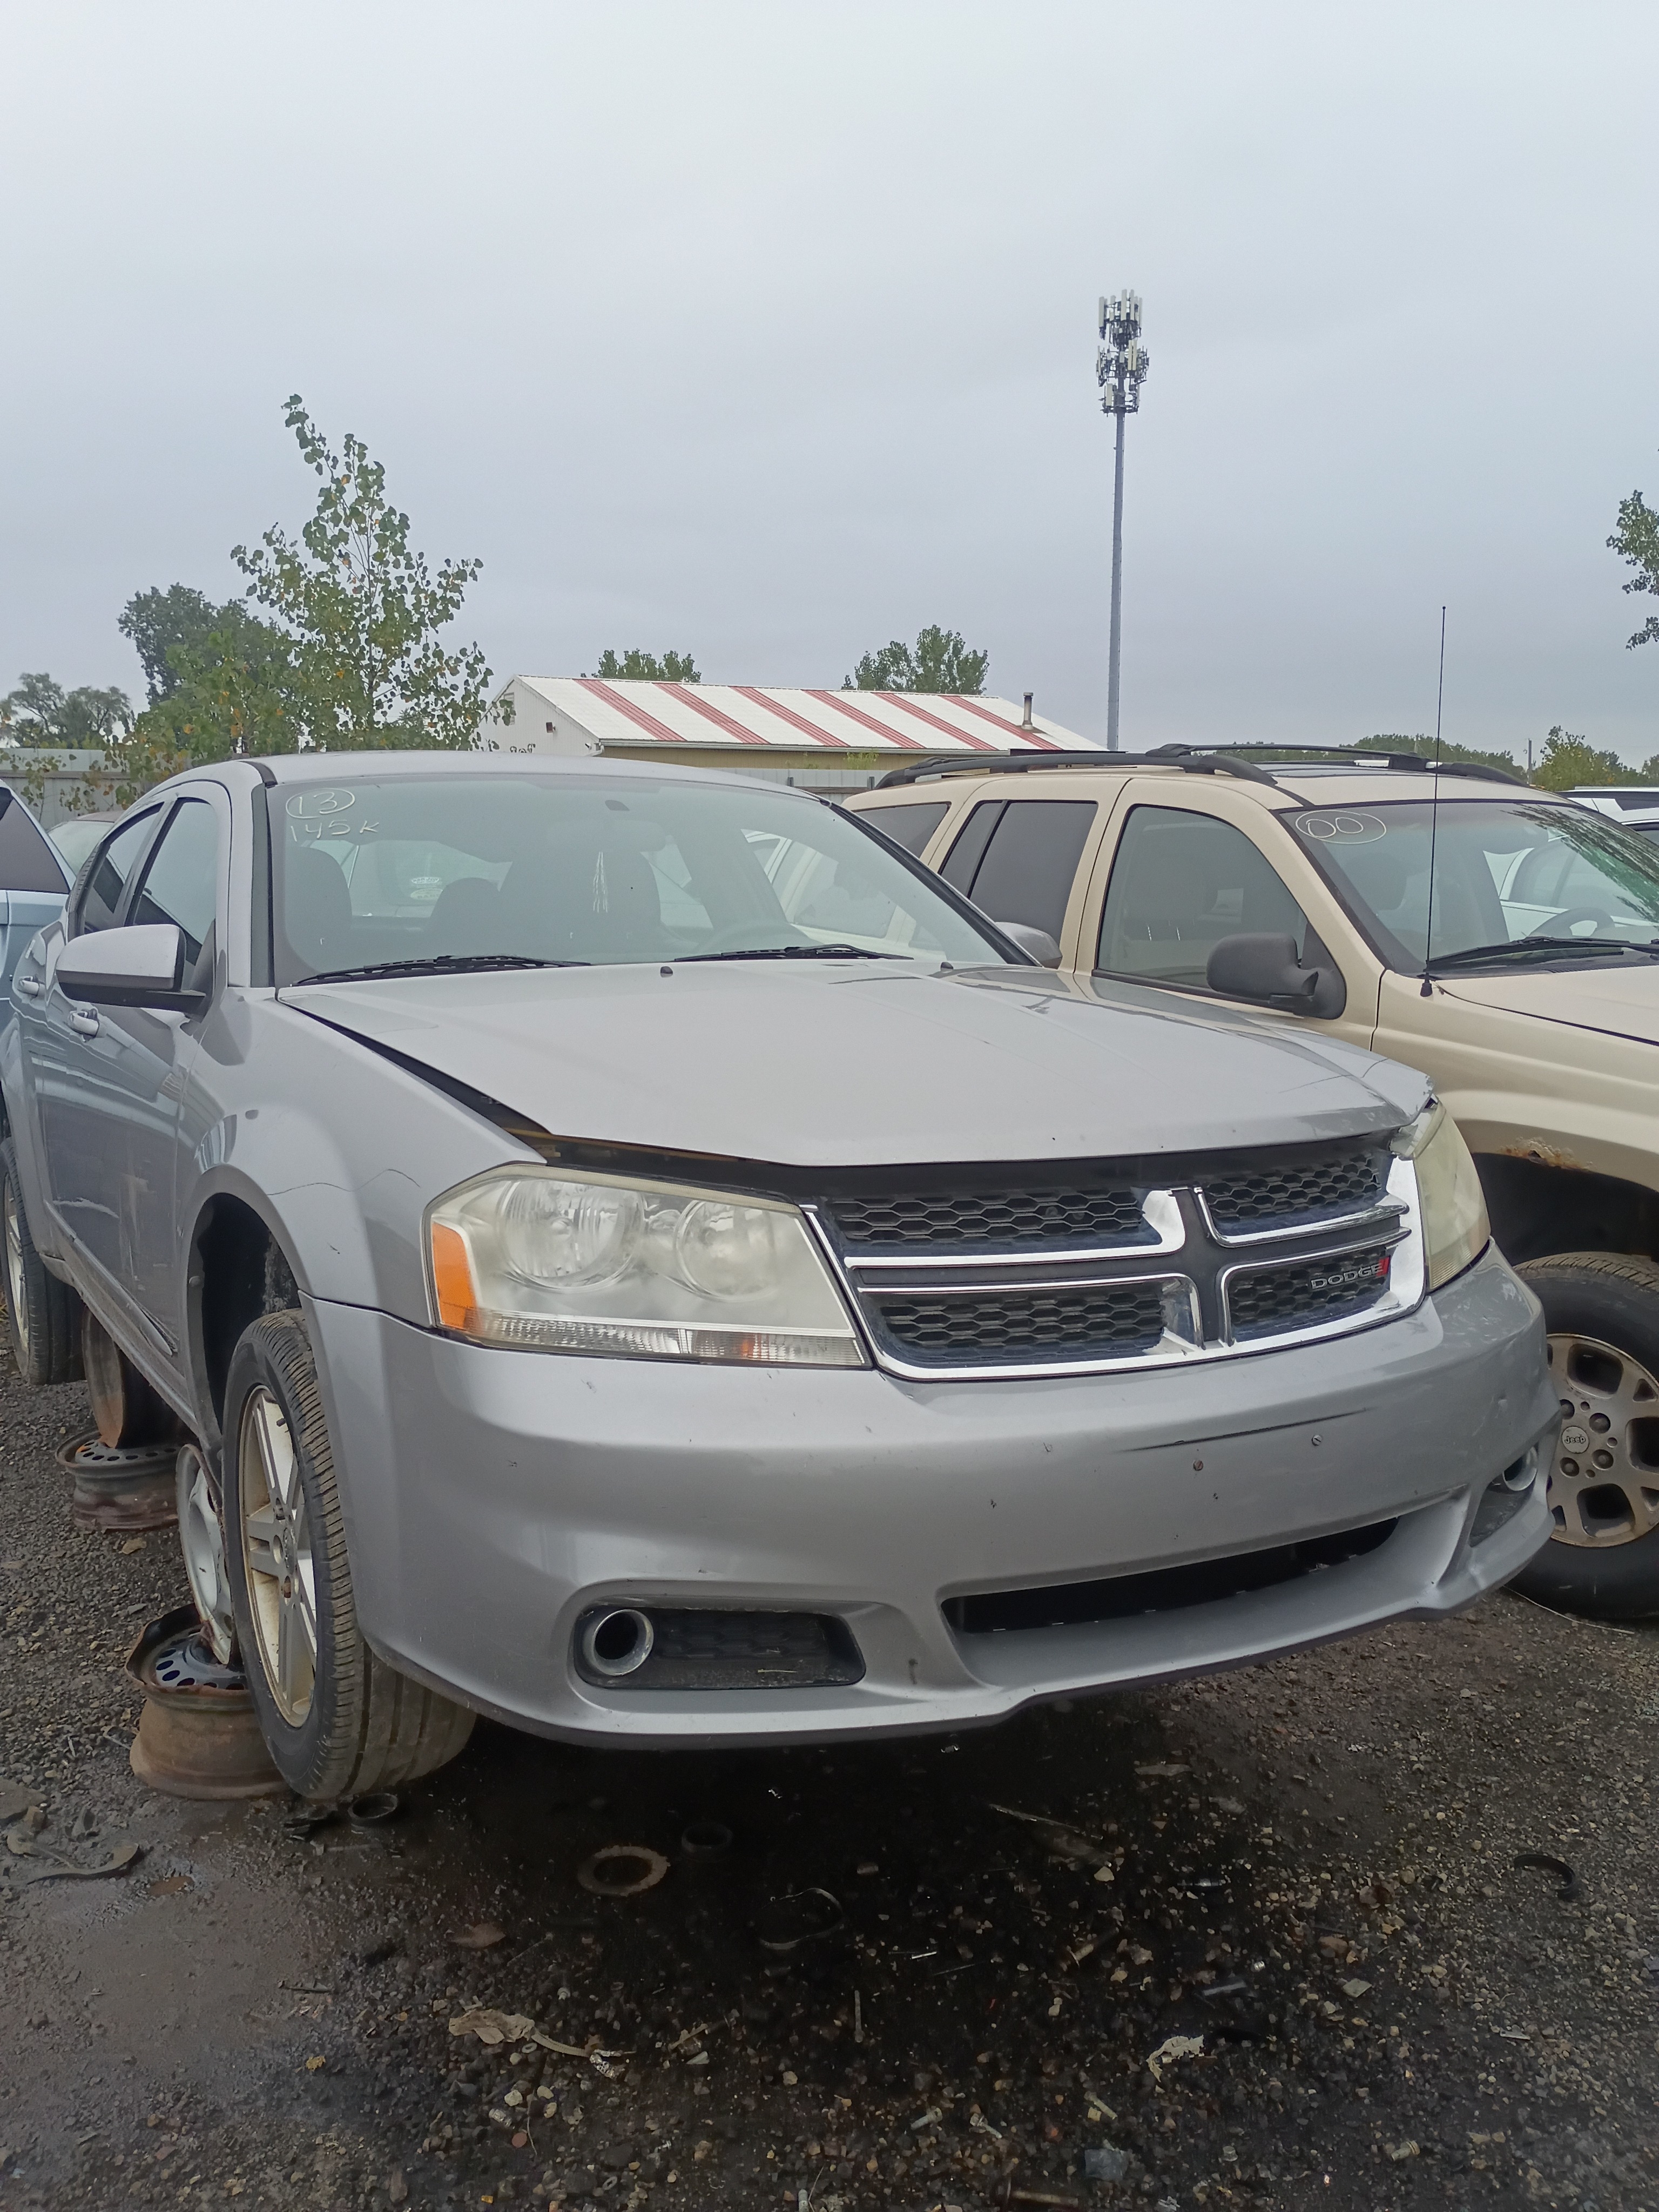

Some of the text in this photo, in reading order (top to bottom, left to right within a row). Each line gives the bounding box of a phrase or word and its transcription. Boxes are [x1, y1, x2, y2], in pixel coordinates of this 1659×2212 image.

[299, 792, 338, 815] 13
[1311, 1263, 1382, 1290] DODGE
[1564, 1435, 1586, 1445] Jeep
